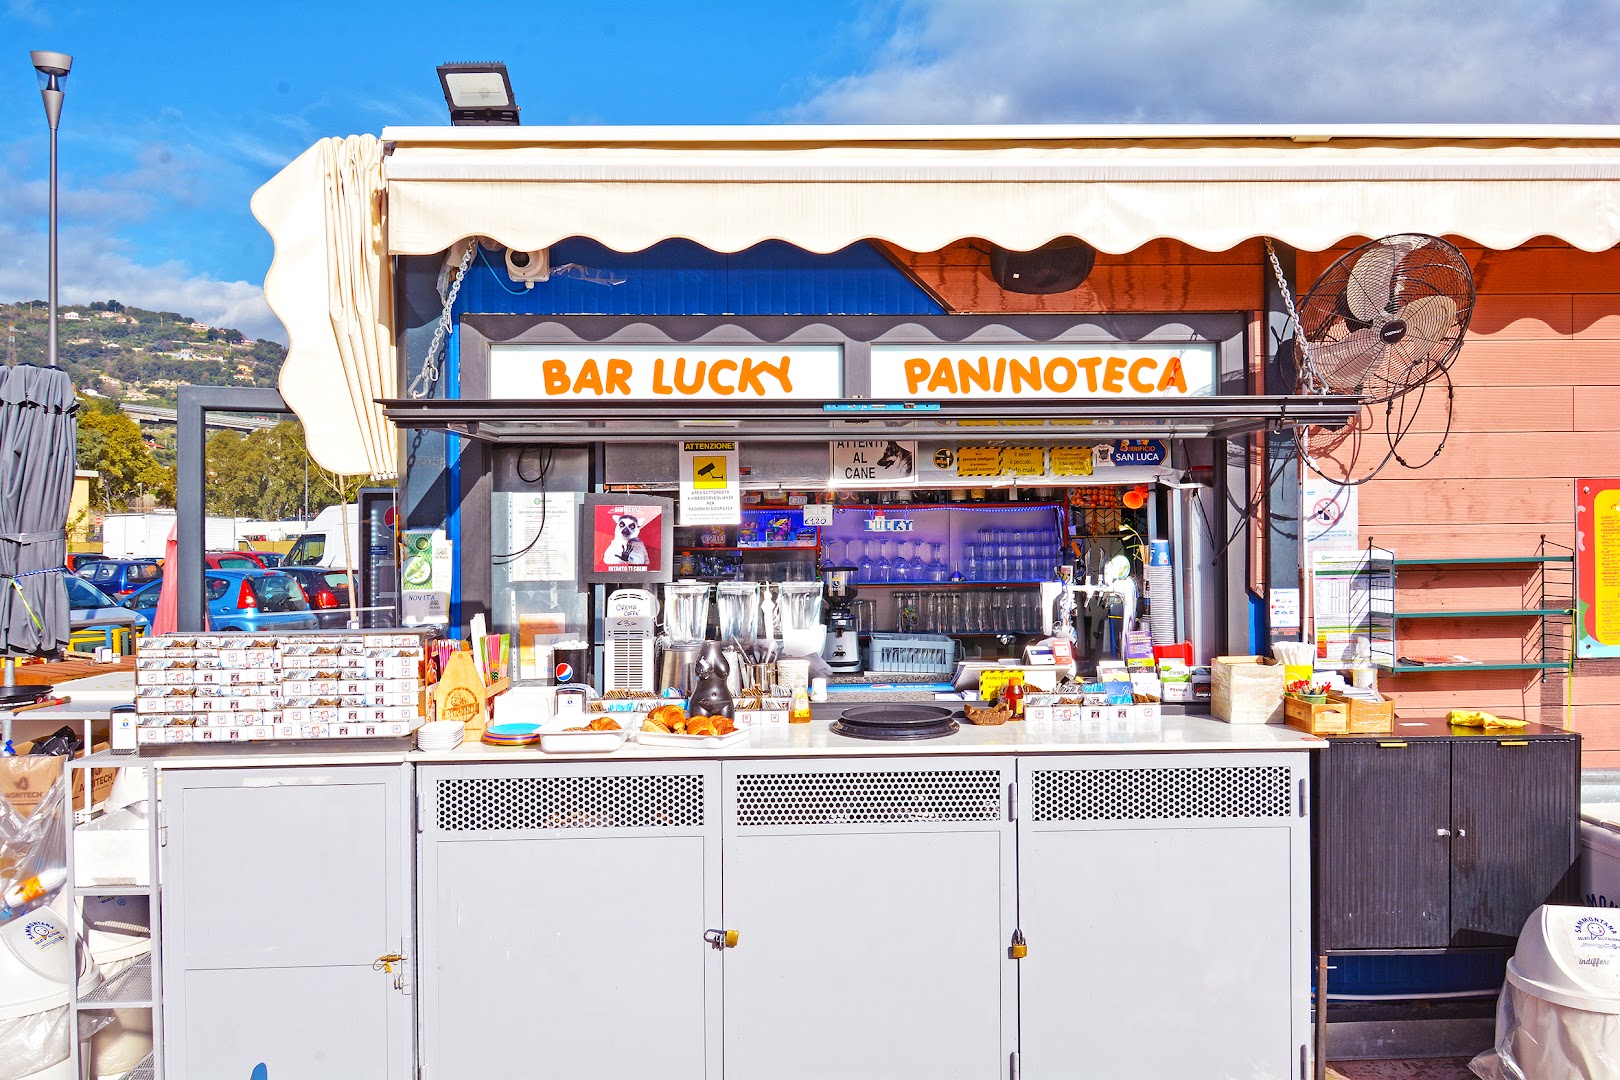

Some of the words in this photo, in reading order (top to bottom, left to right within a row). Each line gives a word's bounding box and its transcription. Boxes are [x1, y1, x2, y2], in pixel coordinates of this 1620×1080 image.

[542, 358, 633, 395] BAR
[652, 356, 793, 396] LUCKY
[904, 356, 1188, 395] PANINOTECA
[684, 442, 735, 450] ATTENZIONE!
[853, 452, 867, 463] AL
[1116, 453, 1134, 461] SAN
[1136, 453, 1159, 461] LUCA
[845, 467, 875, 479] CANE
[865, 520, 913, 530] LUCKY
[1575, 916, 1617, 935] SAMMONTANA
